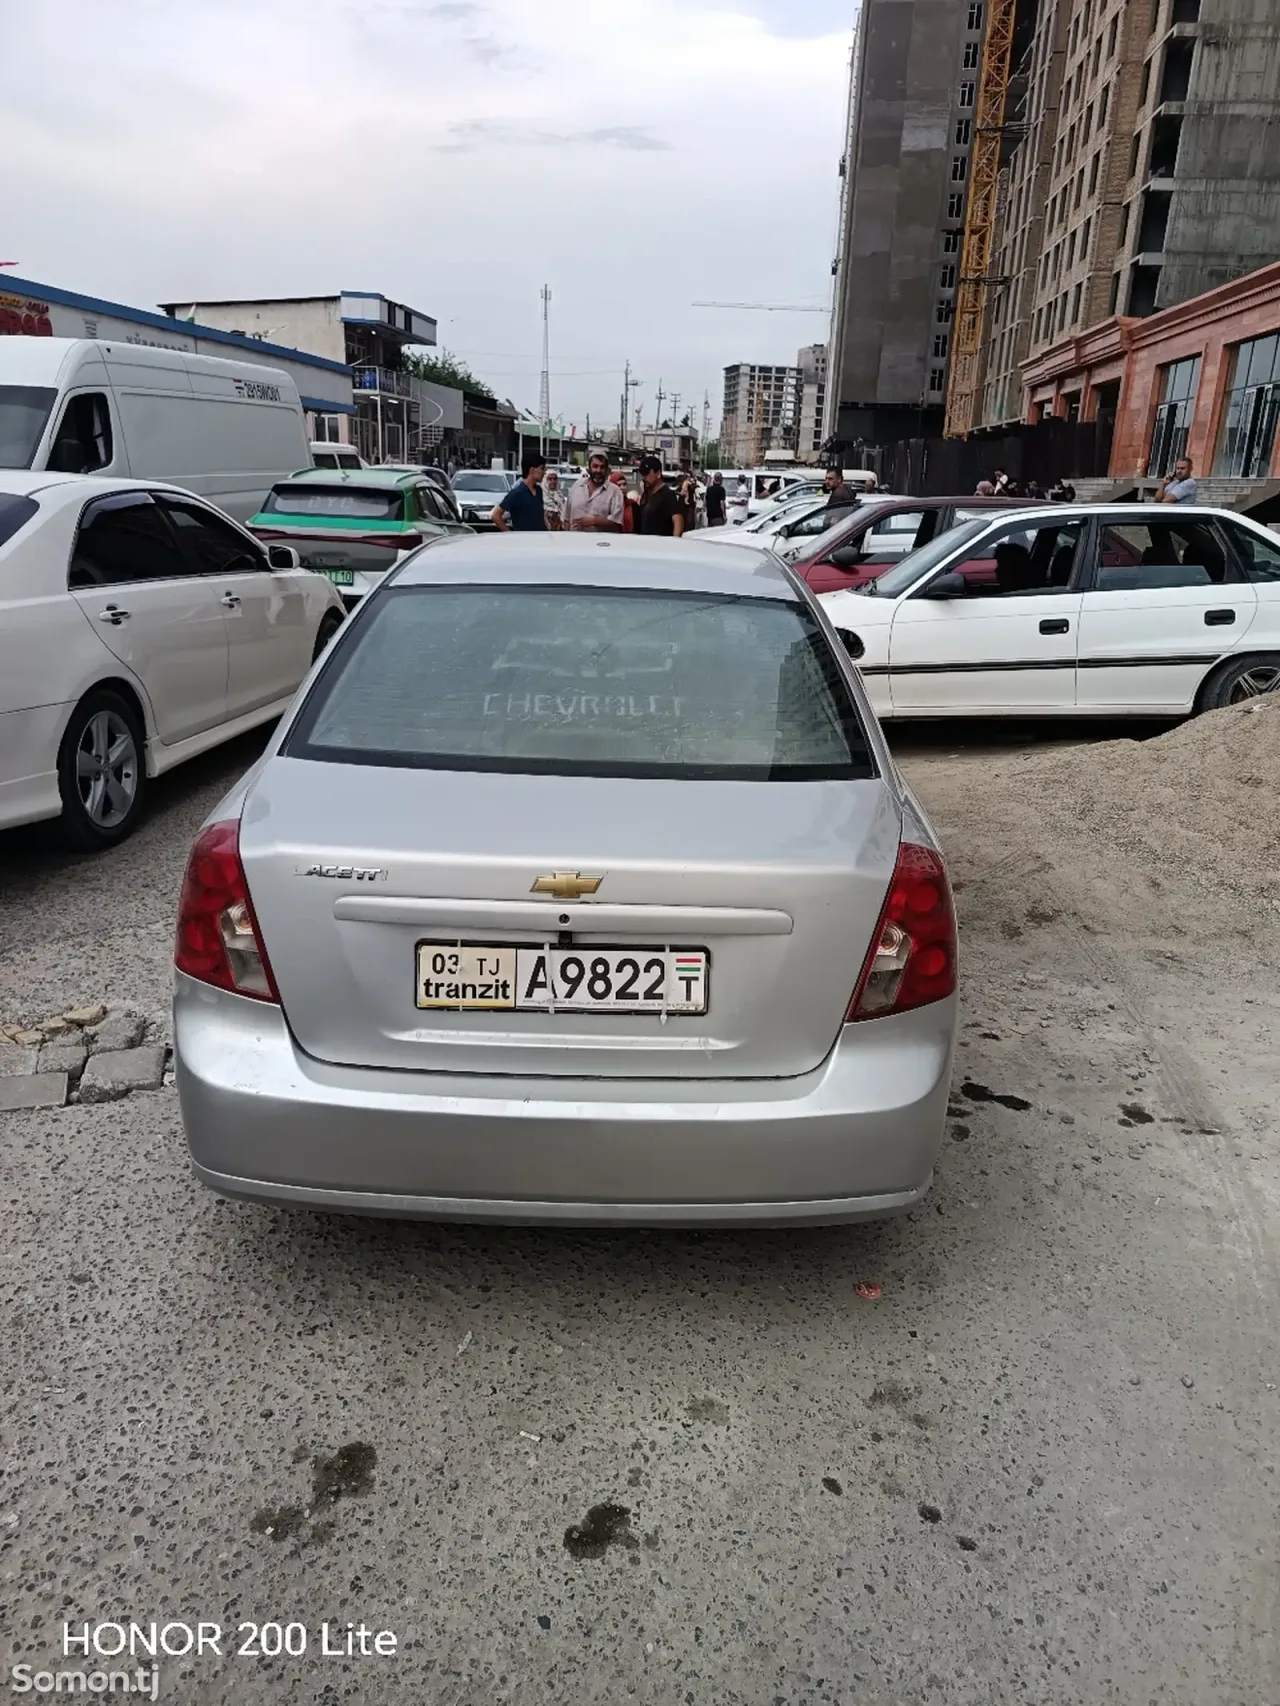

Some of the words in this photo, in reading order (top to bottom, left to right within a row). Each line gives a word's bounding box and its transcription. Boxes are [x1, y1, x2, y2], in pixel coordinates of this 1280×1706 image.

[432, 953, 459, 975] 03
[476, 958, 500, 976] TJ
[423, 978, 510, 1000] tranzit
[524, 955, 666, 1000] A9822
[679, 976, 699, 1001] T
